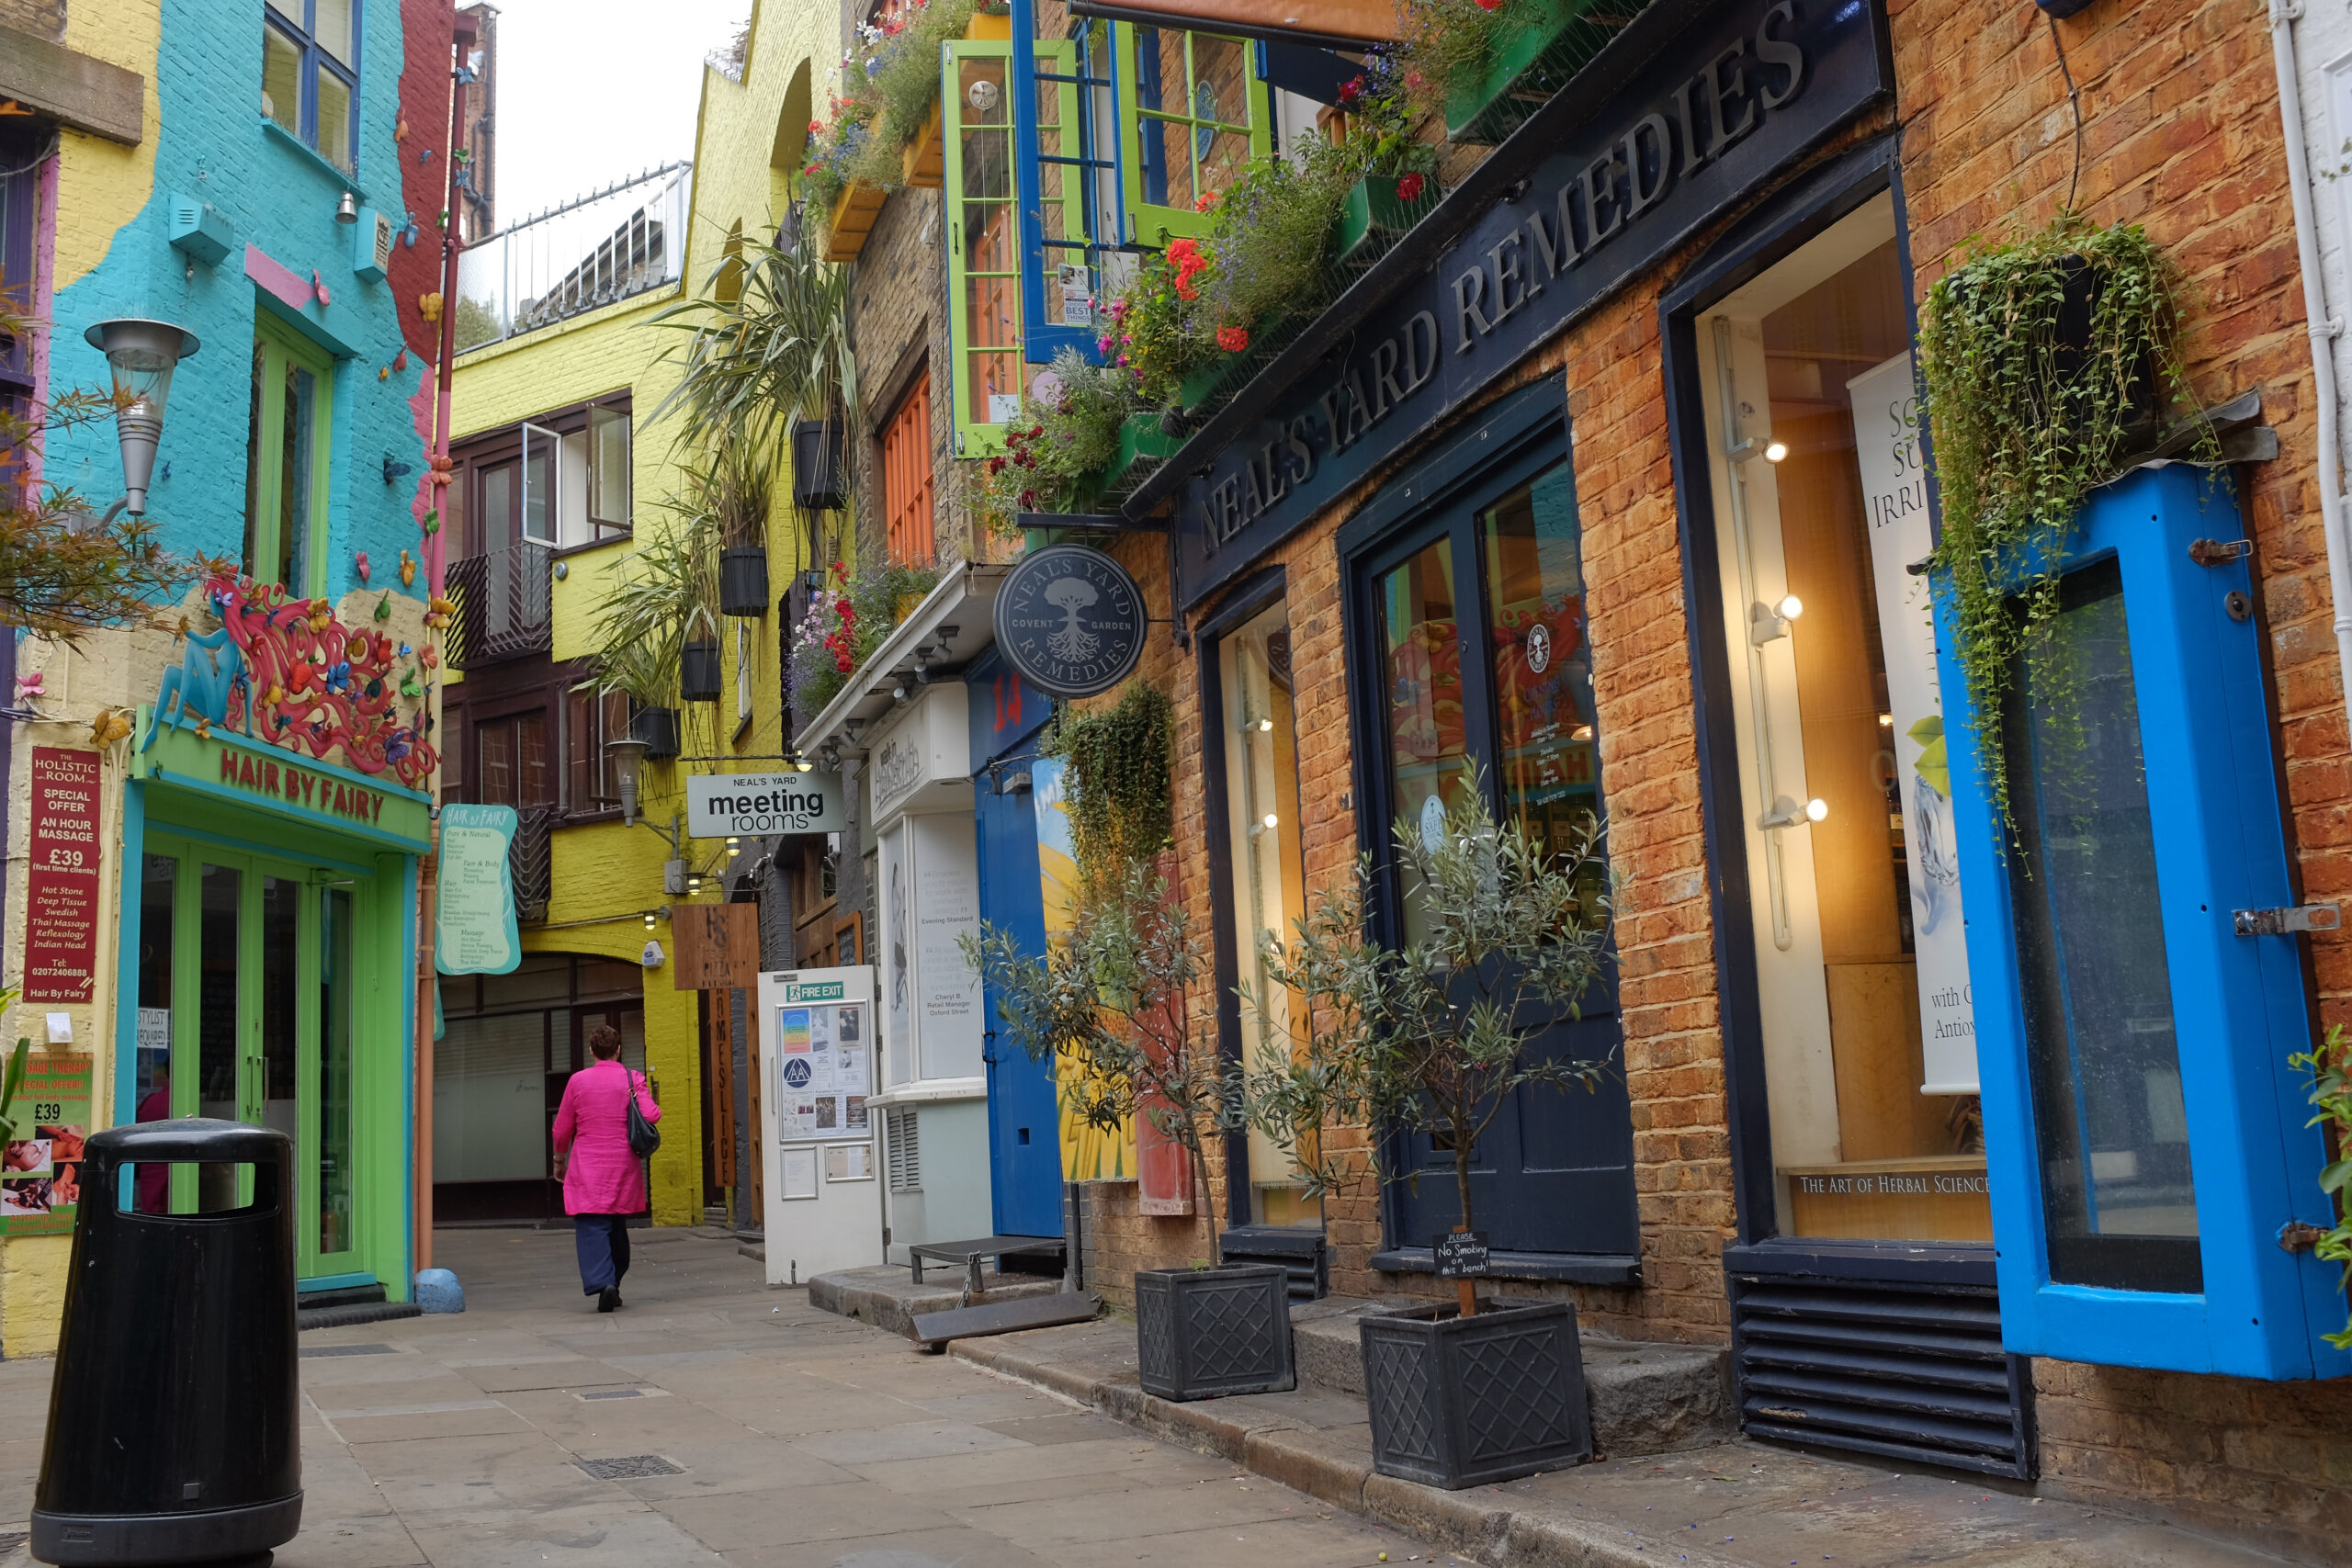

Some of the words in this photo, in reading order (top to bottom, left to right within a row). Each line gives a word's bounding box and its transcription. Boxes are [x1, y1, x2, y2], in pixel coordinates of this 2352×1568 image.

[1198, 414, 1312, 558] NEAL'S
[1318, 310, 1440, 457] YARD
[1451, 1, 1803, 355] REMEDIES
[1066, 307, 1089, 315] BEST
[1871, 478, 1926, 528] IRRI
[1013, 558, 1072, 613] NEAL'S
[1085, 561, 1131, 615] YARD
[1012, 618, 1054, 628] COVENT
[1091, 621, 1131, 630] GARDEN
[1019, 637, 1128, 682] REMEDIES
[993, 672, 1022, 733] 14
[35, 759, 96, 773] HOLISTIC
[46, 771, 85, 784] ROOM
[733, 777, 767, 787] NEAL'S
[772, 776, 797, 785] YARD
[221, 748, 280, 794] HAIR
[286, 768, 316, 804] BY
[322, 778, 385, 822] FAIRY
[44, 788, 91, 801] SPECIAL
[48, 800, 85, 813] OFFER
[708, 789, 824, 818] meeting
[40, 817, 57, 828] AN
[60, 818, 91, 830] HOUR
[446, 807, 469, 825] HAIR
[480, 809, 509, 827] FAIRY
[731, 813, 808, 832] rooms
[39, 829, 94, 842] MASSAGE
[49, 849, 84, 867] £39
[32, 863, 51, 872] (first
[52, 864, 68, 873] time
[70, 867, 96, 876] clients)
[60, 886, 84, 896] Stone
[37, 897, 59, 907] Deep
[62, 897, 87, 907] Tissue
[44, 908, 78, 917] Swedish
[32, 918, 52, 926] Thai
[54, 919, 90, 930] Massage
[922, 917, 944, 925] Evening
[36, 929, 86, 941] Reflexology
[34, 940, 62, 948] Indian
[64, 941, 86, 949] Head
[51, 957, 67, 967] Tel:
[30, 988, 49, 998] Hair
[51, 988, 62, 998] By
[64, 988, 86, 999] Fairy
[801, 987, 821, 998] FIRE
[822, 985, 842, 997] EXIT
[1931, 987, 1960, 1008] with
[138, 1010, 164, 1024] STYLIST
[137, 1029, 165, 1046] EQUIRED
[51, 1061, 90, 1074] THERAPY
[15, 1079, 48, 1090] ECIAL
[715, 988, 729, 1184] OMESLICE
[35, 1103, 61, 1120] £39
[1801, 1177, 1824, 1193] THE
[1829, 1177, 1852, 1193] ART
[1857, 1178, 1873, 1193] OF
[1879, 1176, 1929, 1193] HERBAL
[1449, 1233, 1475, 1241] PLEASE
[1438, 1243, 1452, 1258] No
[1454, 1244, 1487, 1258] Smoking
[1442, 1266, 1456, 1276] this
[1463, 1259, 1489, 1273] bench!
